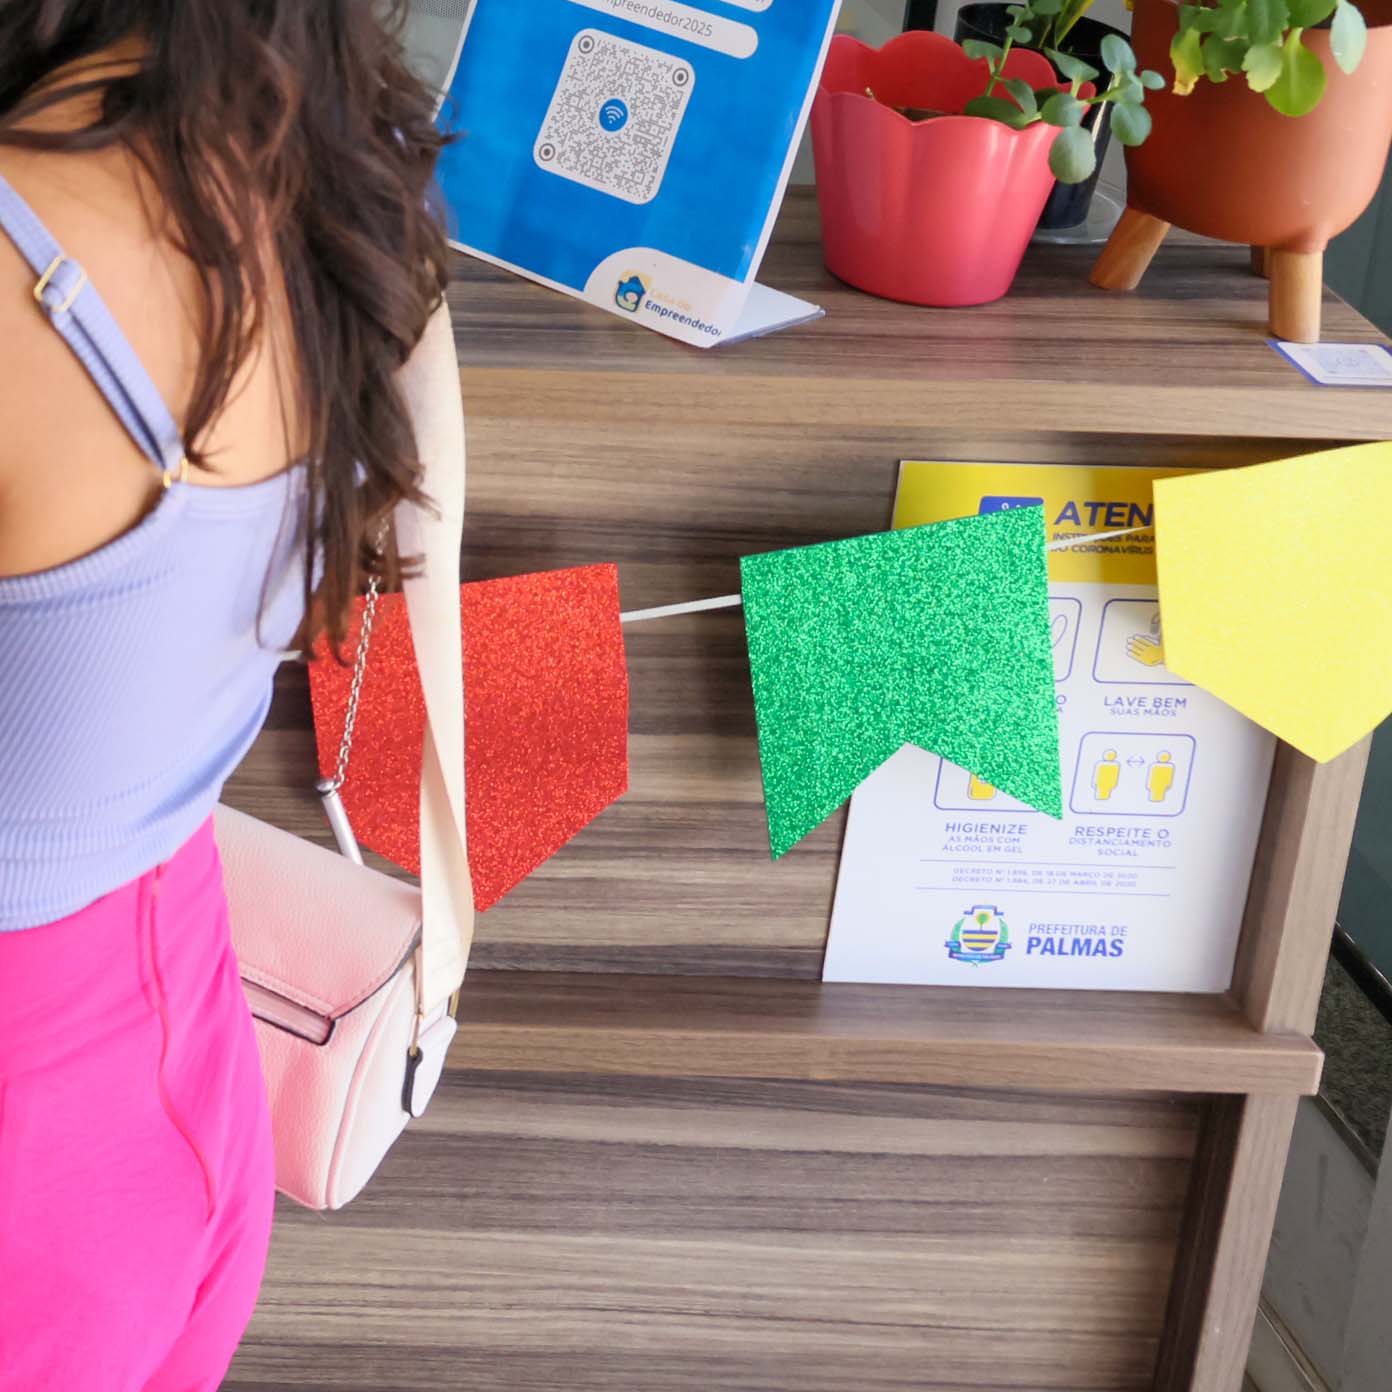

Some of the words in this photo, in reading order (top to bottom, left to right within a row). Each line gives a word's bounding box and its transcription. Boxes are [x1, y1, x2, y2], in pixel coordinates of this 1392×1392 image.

[1054, 500, 1154, 527] ATEN
[1104, 696, 1148, 707] LAVE
[1152, 697, 1187, 709] BEM
[1110, 707, 1140, 716] SUAS
[944, 823, 1028, 835] HIGIENIZE
[1074, 826, 1153, 839] RESPEITE
[1156, 828, 1169, 839] O
[997, 836, 1021, 844] COM
[1068, 837, 1173, 848] DISTANCIAMENTO
[986, 845, 1002, 853] EM
[1097, 848, 1139, 856] SOCIAL
[1028, 923, 1106, 936] PREFEITURA
[1110, 925, 1127, 937] DE
[1026, 936, 1124, 957] PALMAS
